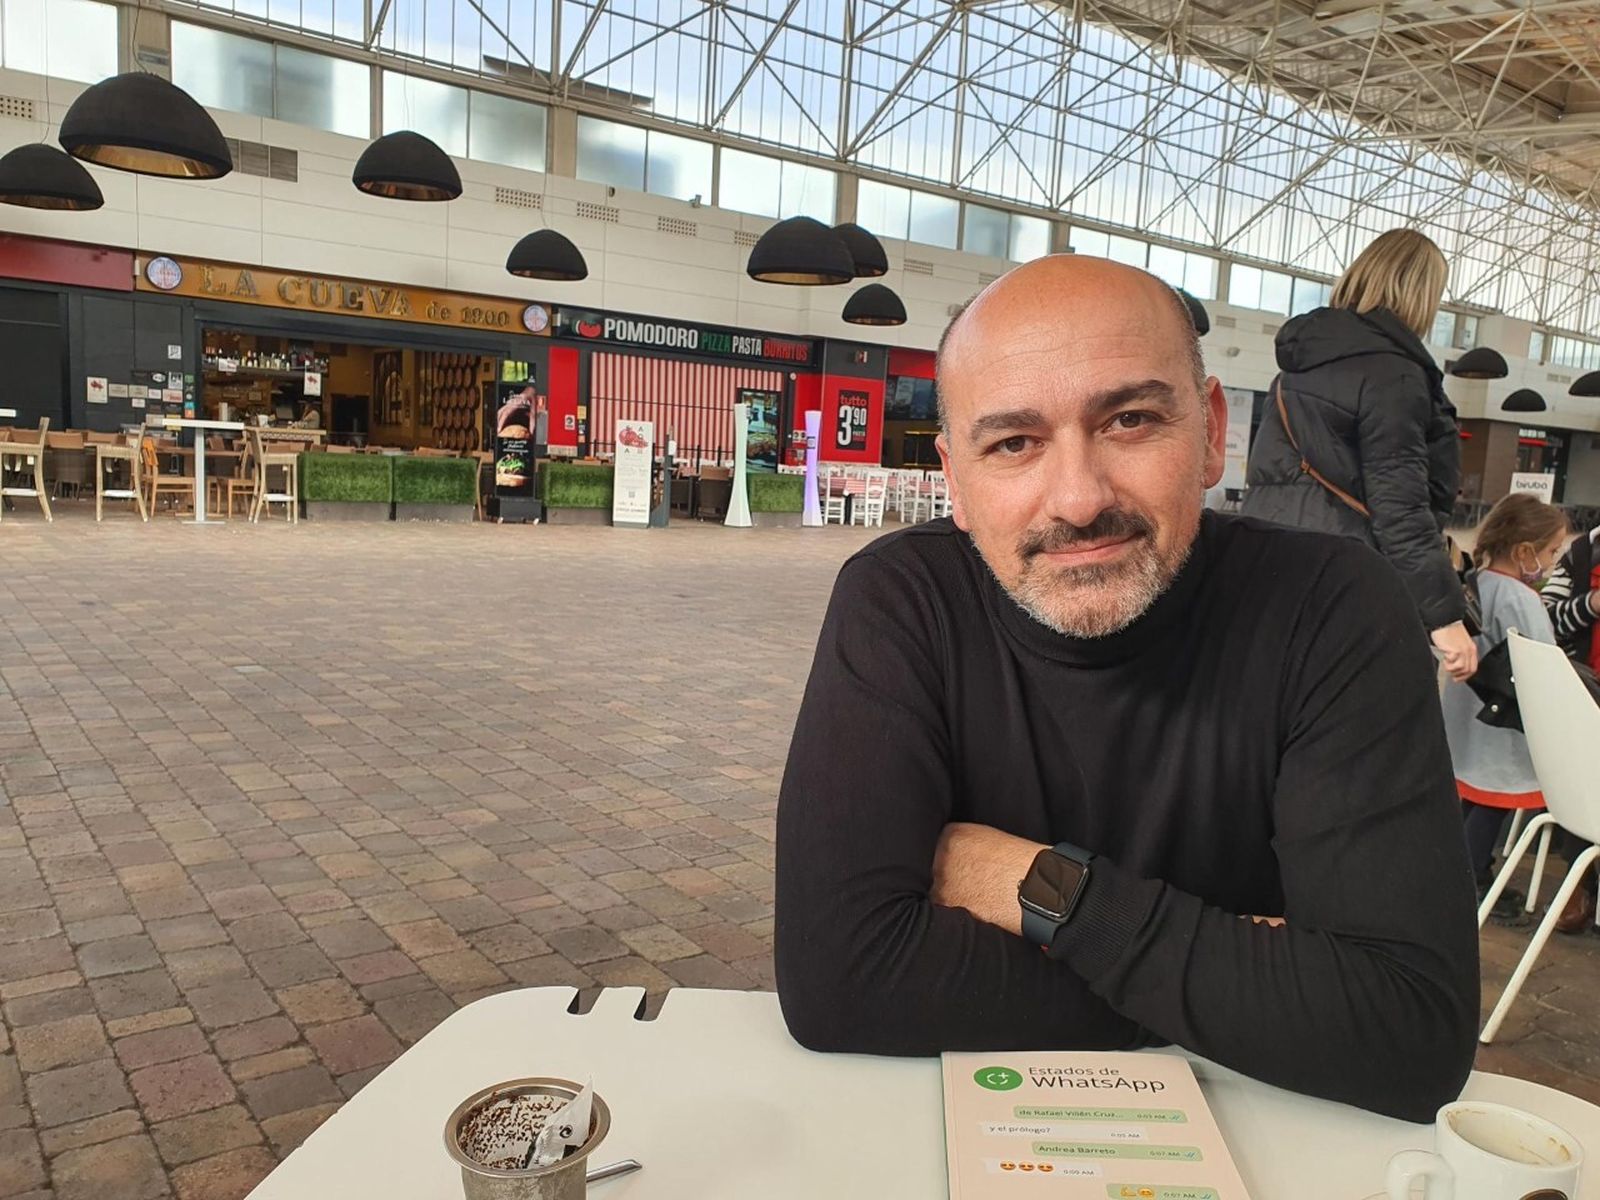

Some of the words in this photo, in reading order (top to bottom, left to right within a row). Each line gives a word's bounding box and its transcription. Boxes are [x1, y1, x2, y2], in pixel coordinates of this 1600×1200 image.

[200, 263, 260, 298] LA
[278, 275, 411, 316] CUEVA
[425, 300, 450, 320] de
[461, 306, 509, 328] 1900
[604, 317, 698, 349] POMODORO
[701, 332, 731, 353] PIZZA
[732, 335, 762, 356] PASTA
[763, 338, 809, 361] BURRITOS
[840, 395, 867, 406] tutto
[1028, 1066, 1094, 1076] Estados
[1099, 1067, 1119, 1076] de
[1031, 1075, 1165, 1094] WhatsApp
[1034, 1109, 1063, 1117] Rafael
[1008, 1126, 1051, 1134] prólogo?
[1038, 1145, 1075, 1153] Andrea
[1077, 1146, 1116, 1155] Barreto
